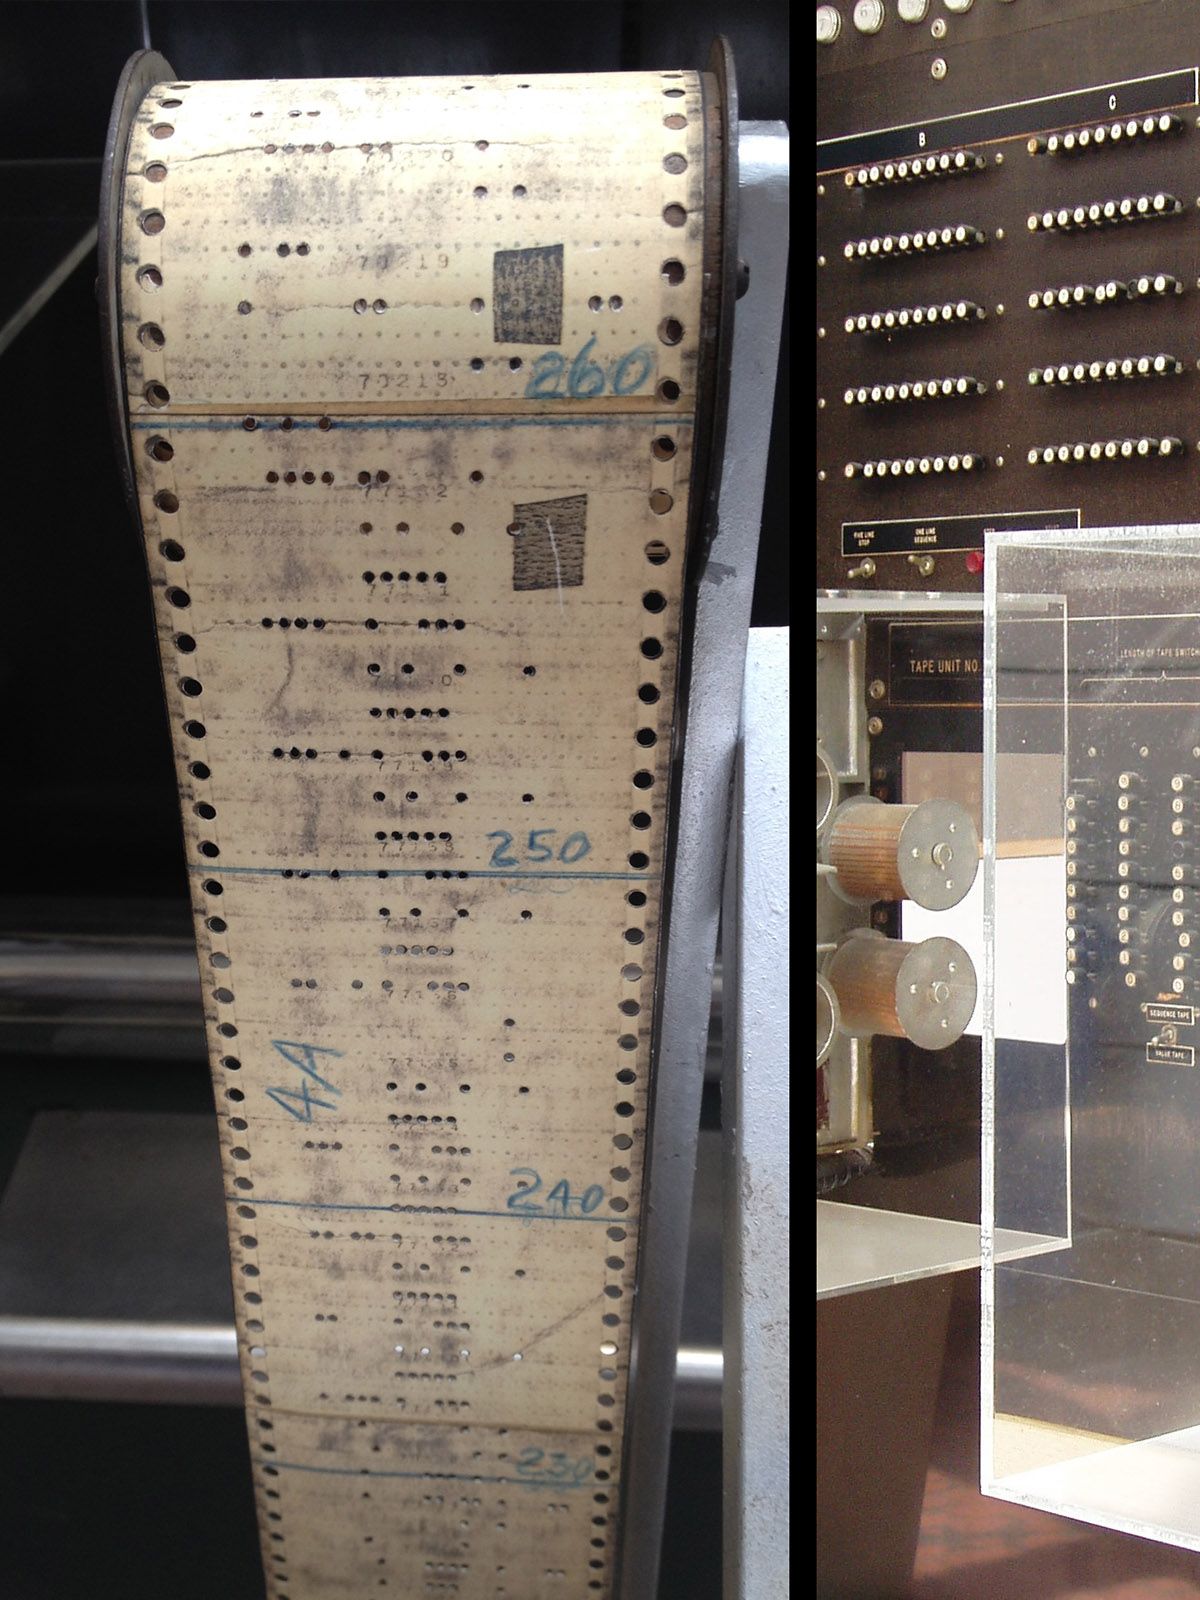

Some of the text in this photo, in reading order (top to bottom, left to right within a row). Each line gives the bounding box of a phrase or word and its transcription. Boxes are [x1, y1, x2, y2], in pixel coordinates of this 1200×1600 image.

[919, 94, 1117, 147] B C
[524, 335, 655, 399] 260
[910, 660, 934, 673] TAPE
[938, 659, 960, 672] UNIT
[485, 829, 592, 867] 250
[516, 1446, 595, 1489] 230
